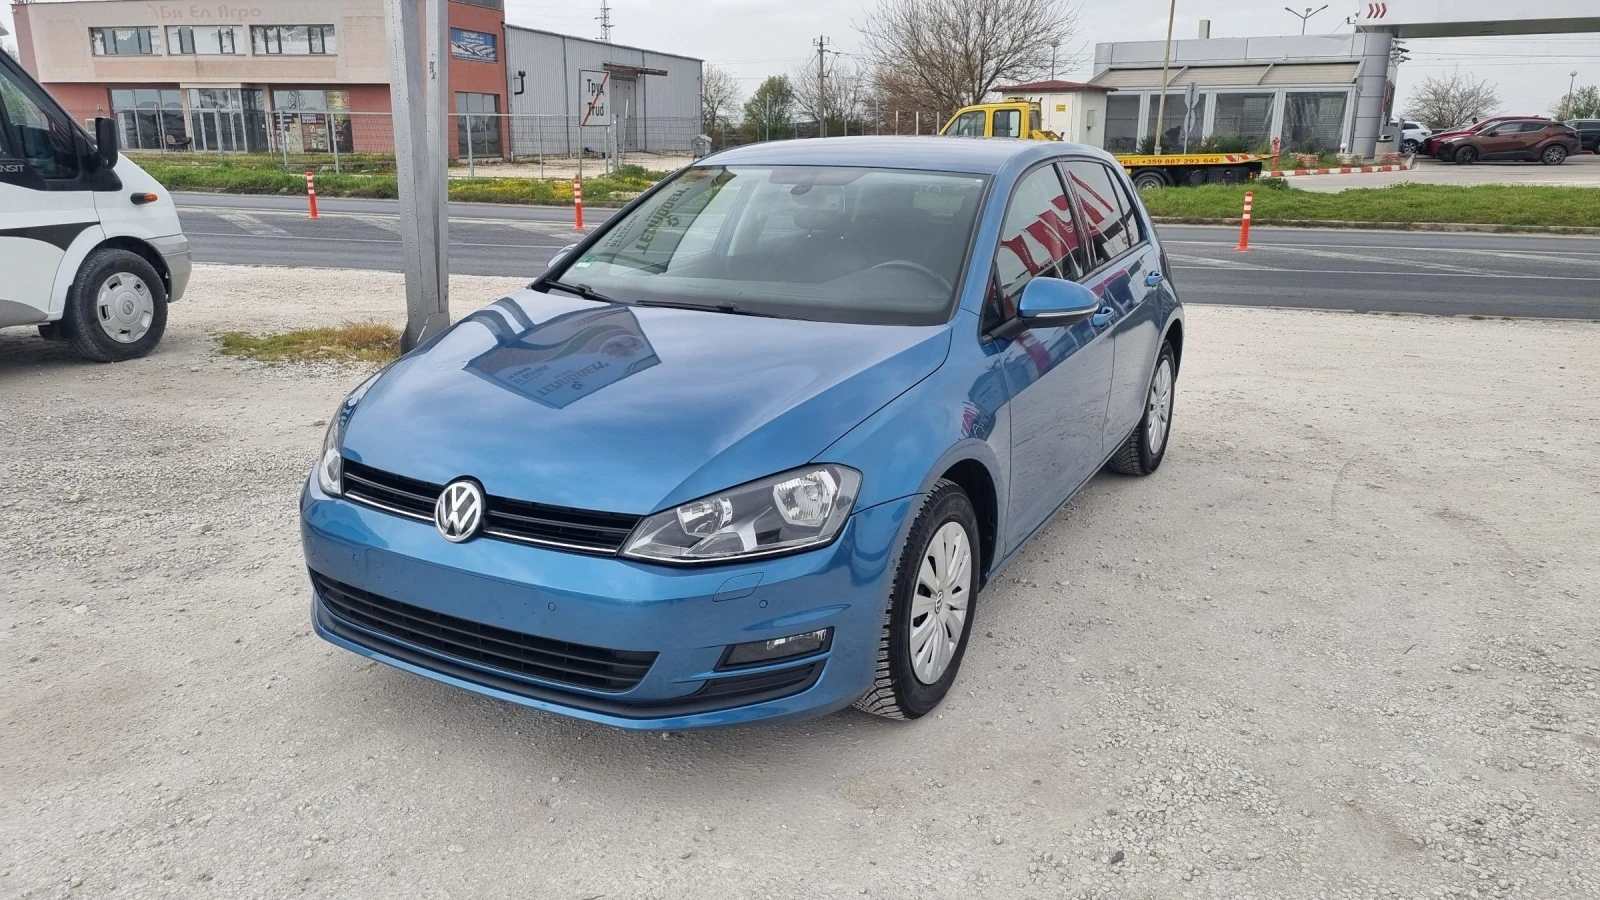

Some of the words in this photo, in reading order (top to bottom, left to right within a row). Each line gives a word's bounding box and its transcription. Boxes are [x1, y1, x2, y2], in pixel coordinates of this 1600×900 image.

[160, 6, 182, 18] Би
[190, 5, 210, 18] Ел
[218, 5, 262, 20] Агро
[588, 102, 604, 116] Trud
[0, 164, 24, 172] NSIT
[436, 481, 481, 541] VW
